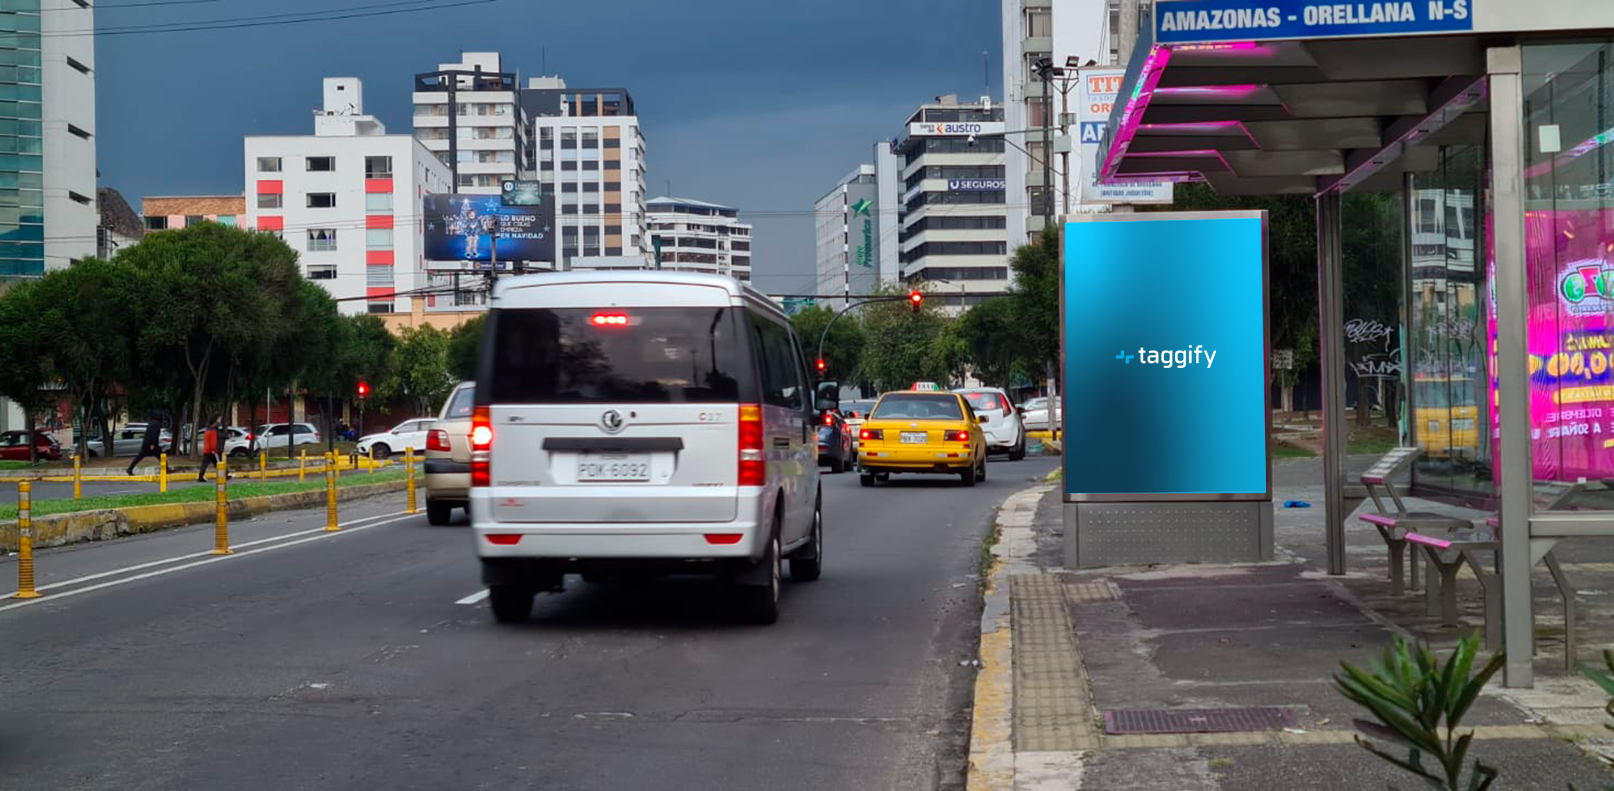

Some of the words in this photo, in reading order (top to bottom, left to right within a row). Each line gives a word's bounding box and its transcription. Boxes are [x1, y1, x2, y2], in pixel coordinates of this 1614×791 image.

[1161, 7, 1281, 32] AMAZONAS
[1304, 1, 1415, 26] ORELLANA
[1428, 0, 1468, 20] N-S
[945, 123, 981, 133] austro
[961, 181, 1005, 189] SEGUROS
[1138, 345, 1216, 368] taggify
